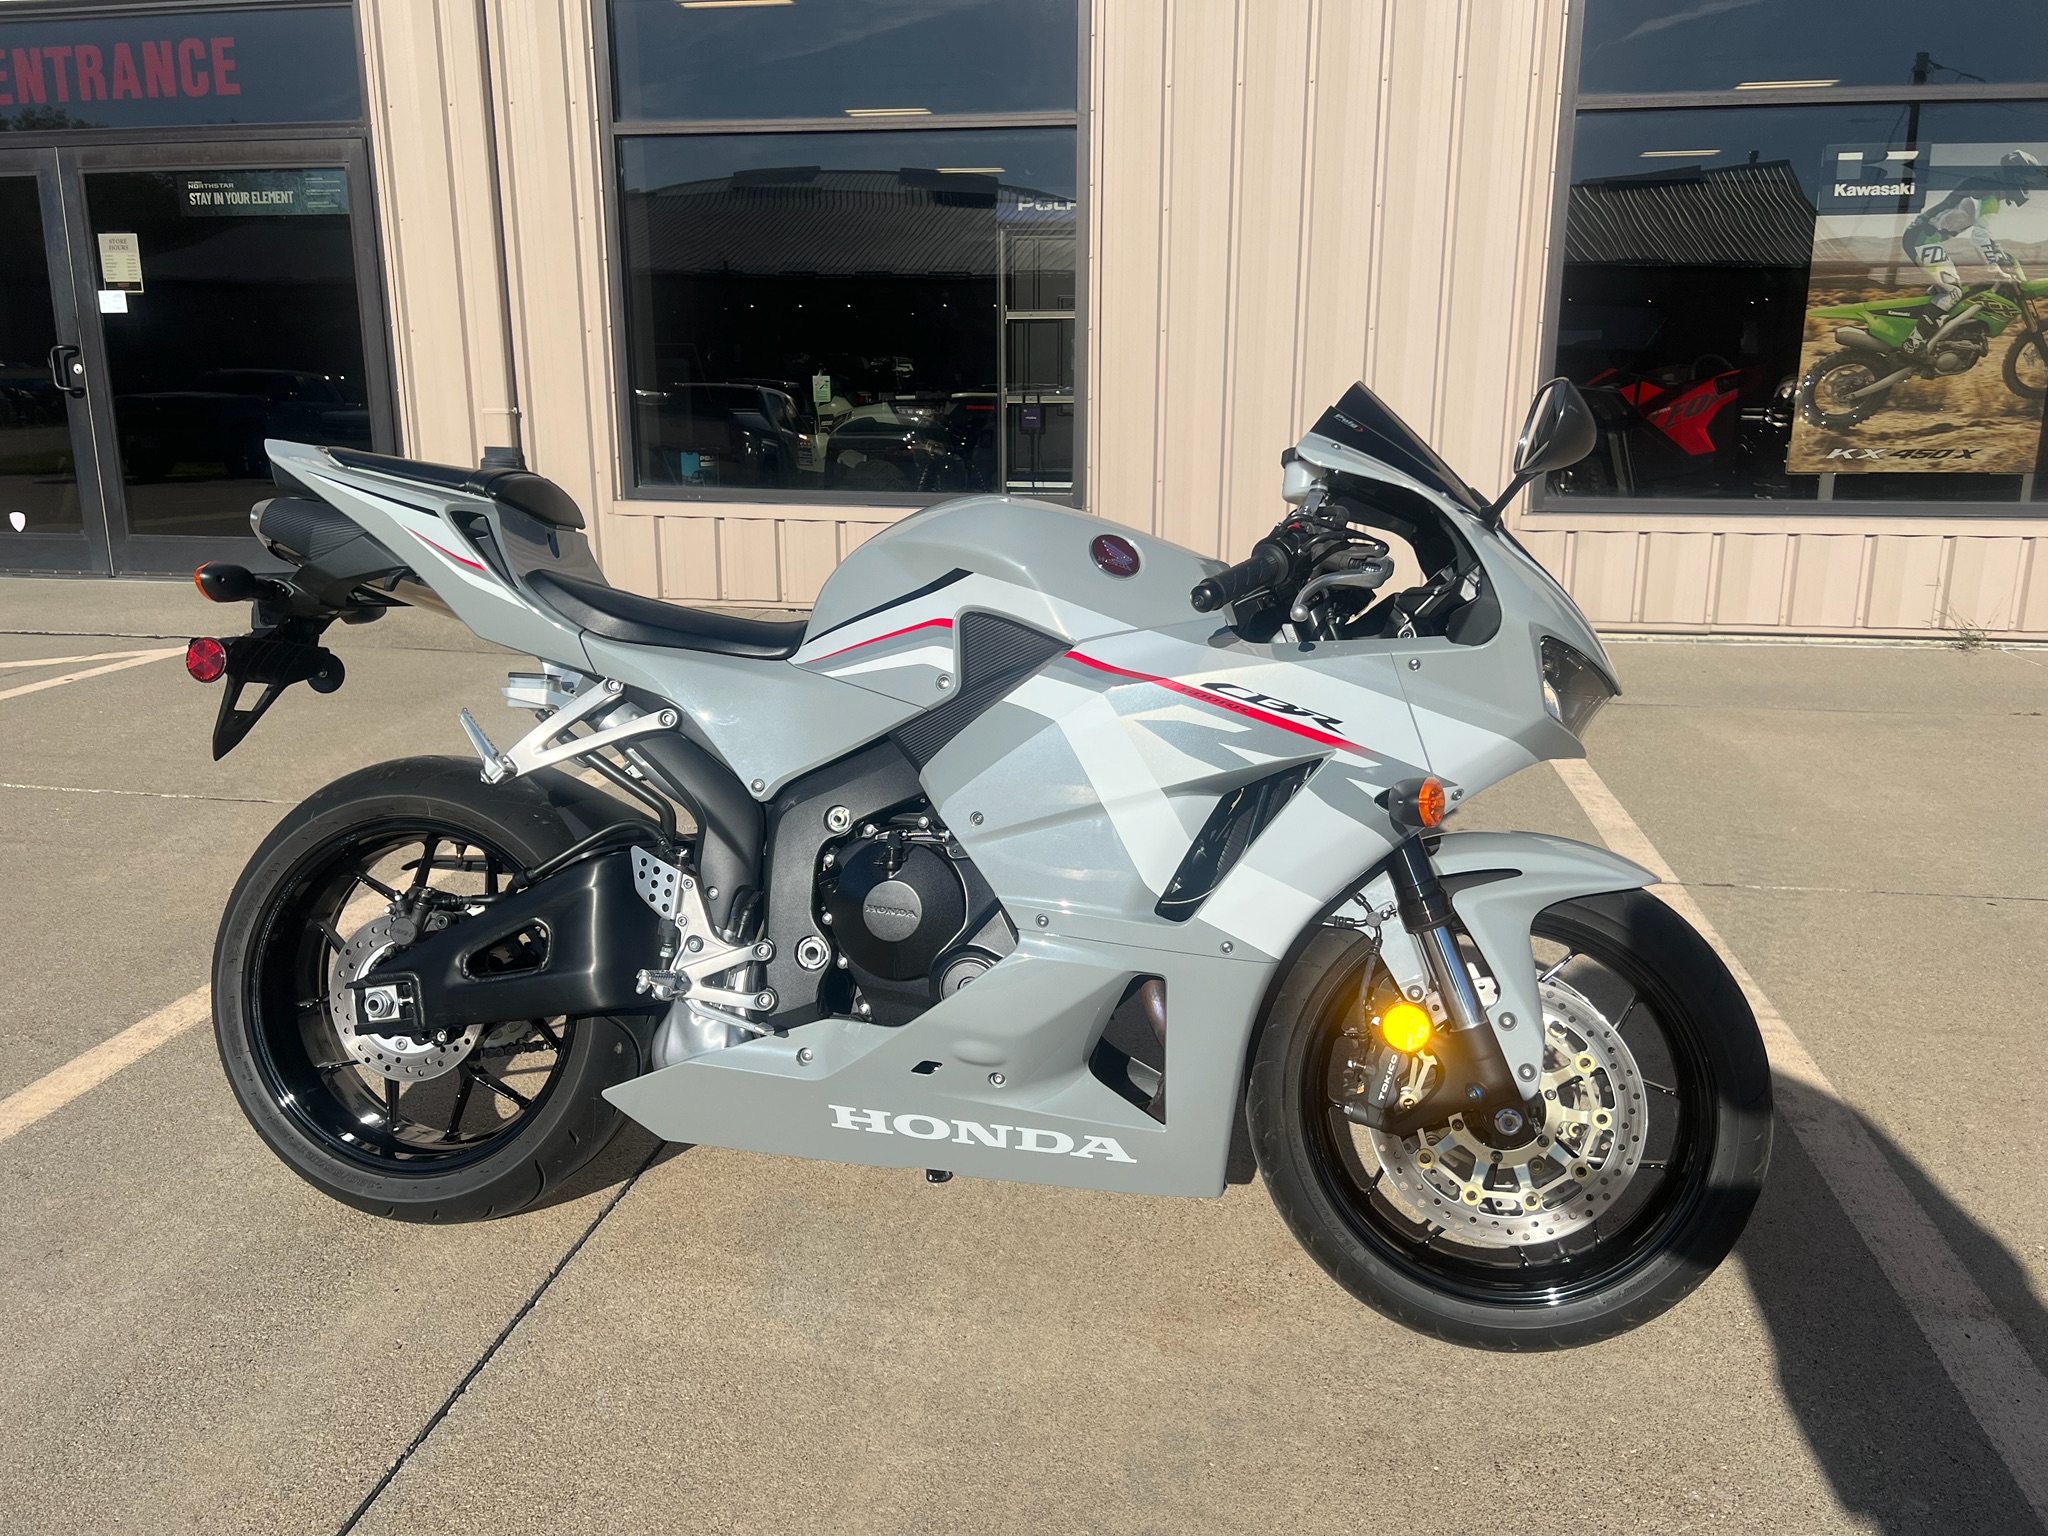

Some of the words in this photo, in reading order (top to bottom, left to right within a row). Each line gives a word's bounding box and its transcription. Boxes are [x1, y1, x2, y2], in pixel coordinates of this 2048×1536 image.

[189, 192, 212, 206] STAY
[213, 191, 224, 205] IN
[225, 191, 250, 205] YOUR
[251, 190, 294, 204] ELEMENT
[1834, 183, 1916, 197] Kawasaki
[1200, 683, 1346, 736] CBR
[865, 904, 918, 919] HONDA
[1378, 1054, 1398, 1101] TOKICO
[828, 1104, 1138, 1164] HONDA
